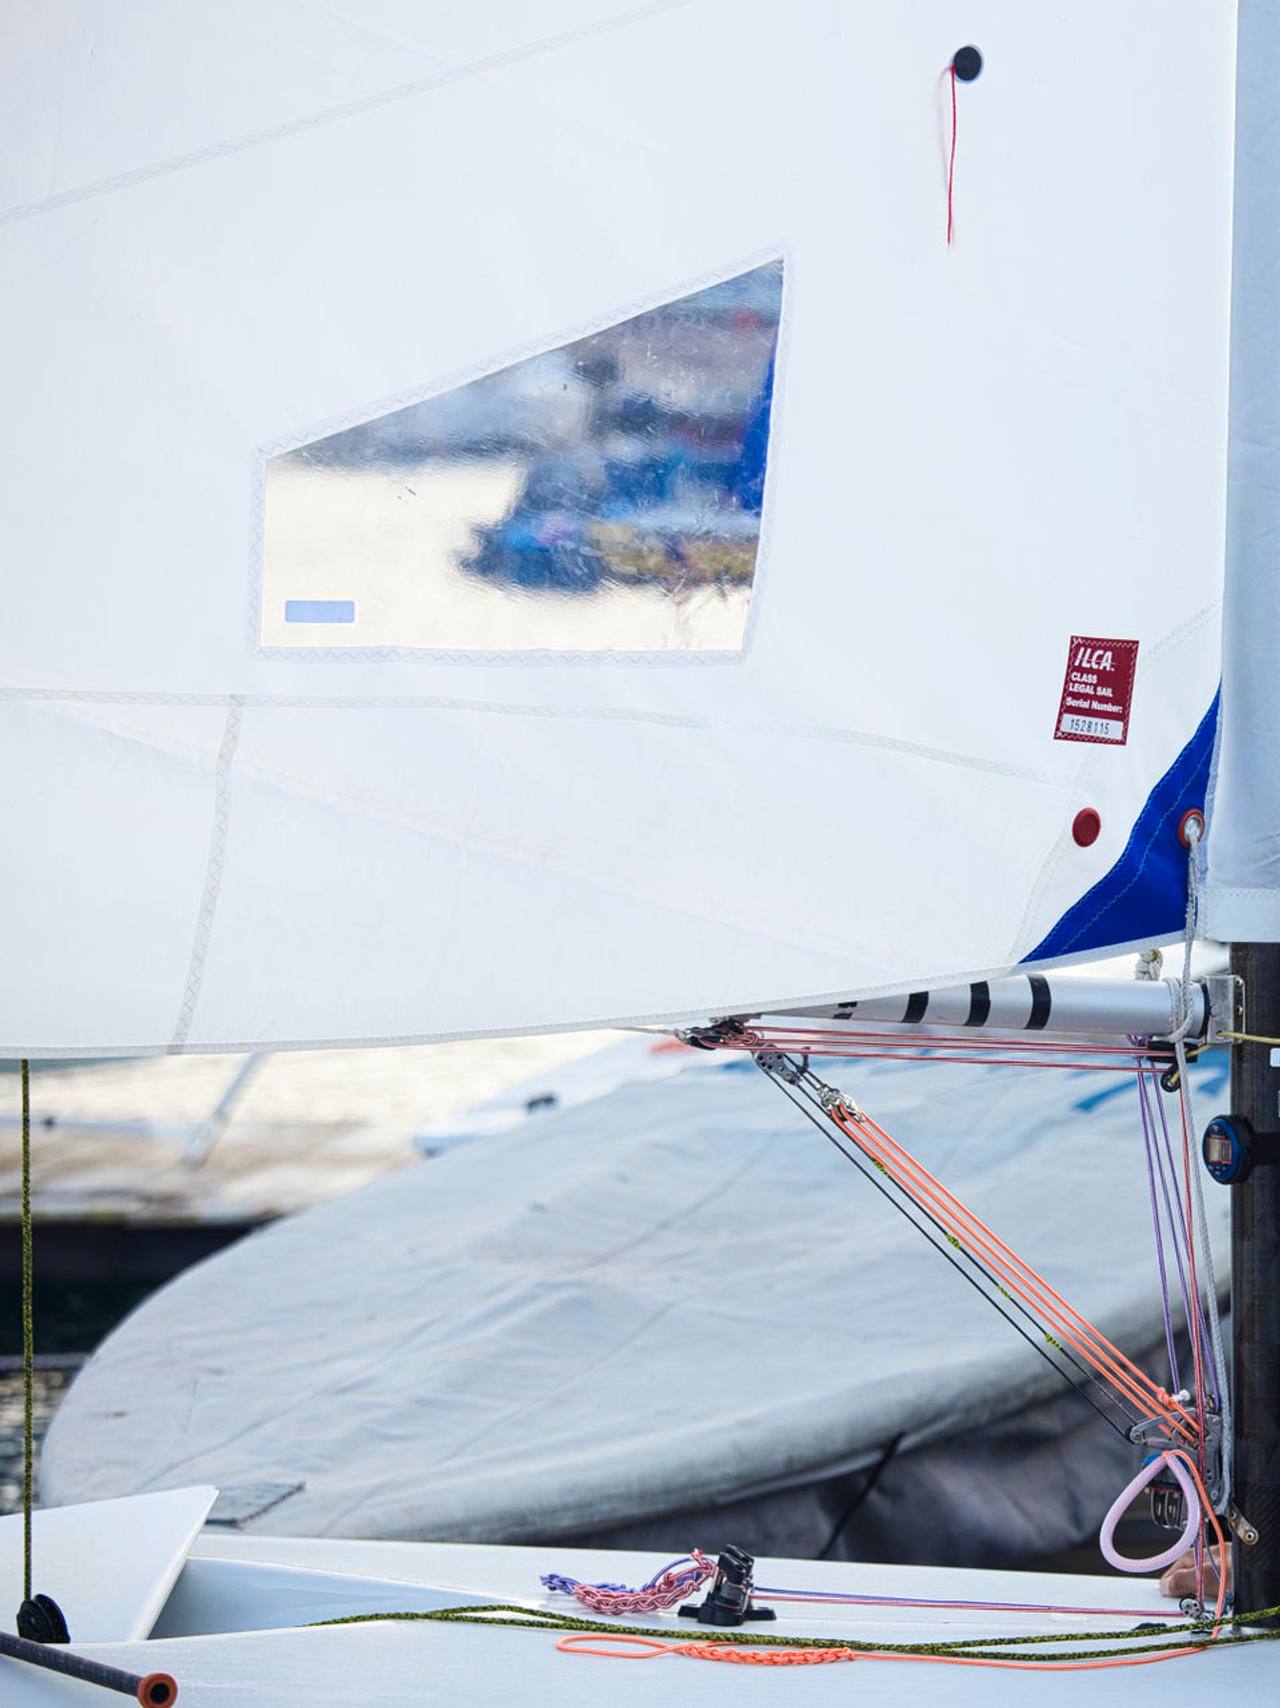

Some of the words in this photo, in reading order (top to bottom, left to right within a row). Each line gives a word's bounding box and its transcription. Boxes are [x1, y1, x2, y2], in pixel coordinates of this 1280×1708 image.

[1071, 672, 1098, 684] CLASS
[1069, 683, 1095, 695] LEGAL
[1096, 687, 1113, 697] SAIL
[1066, 697, 1090, 709] Serial
